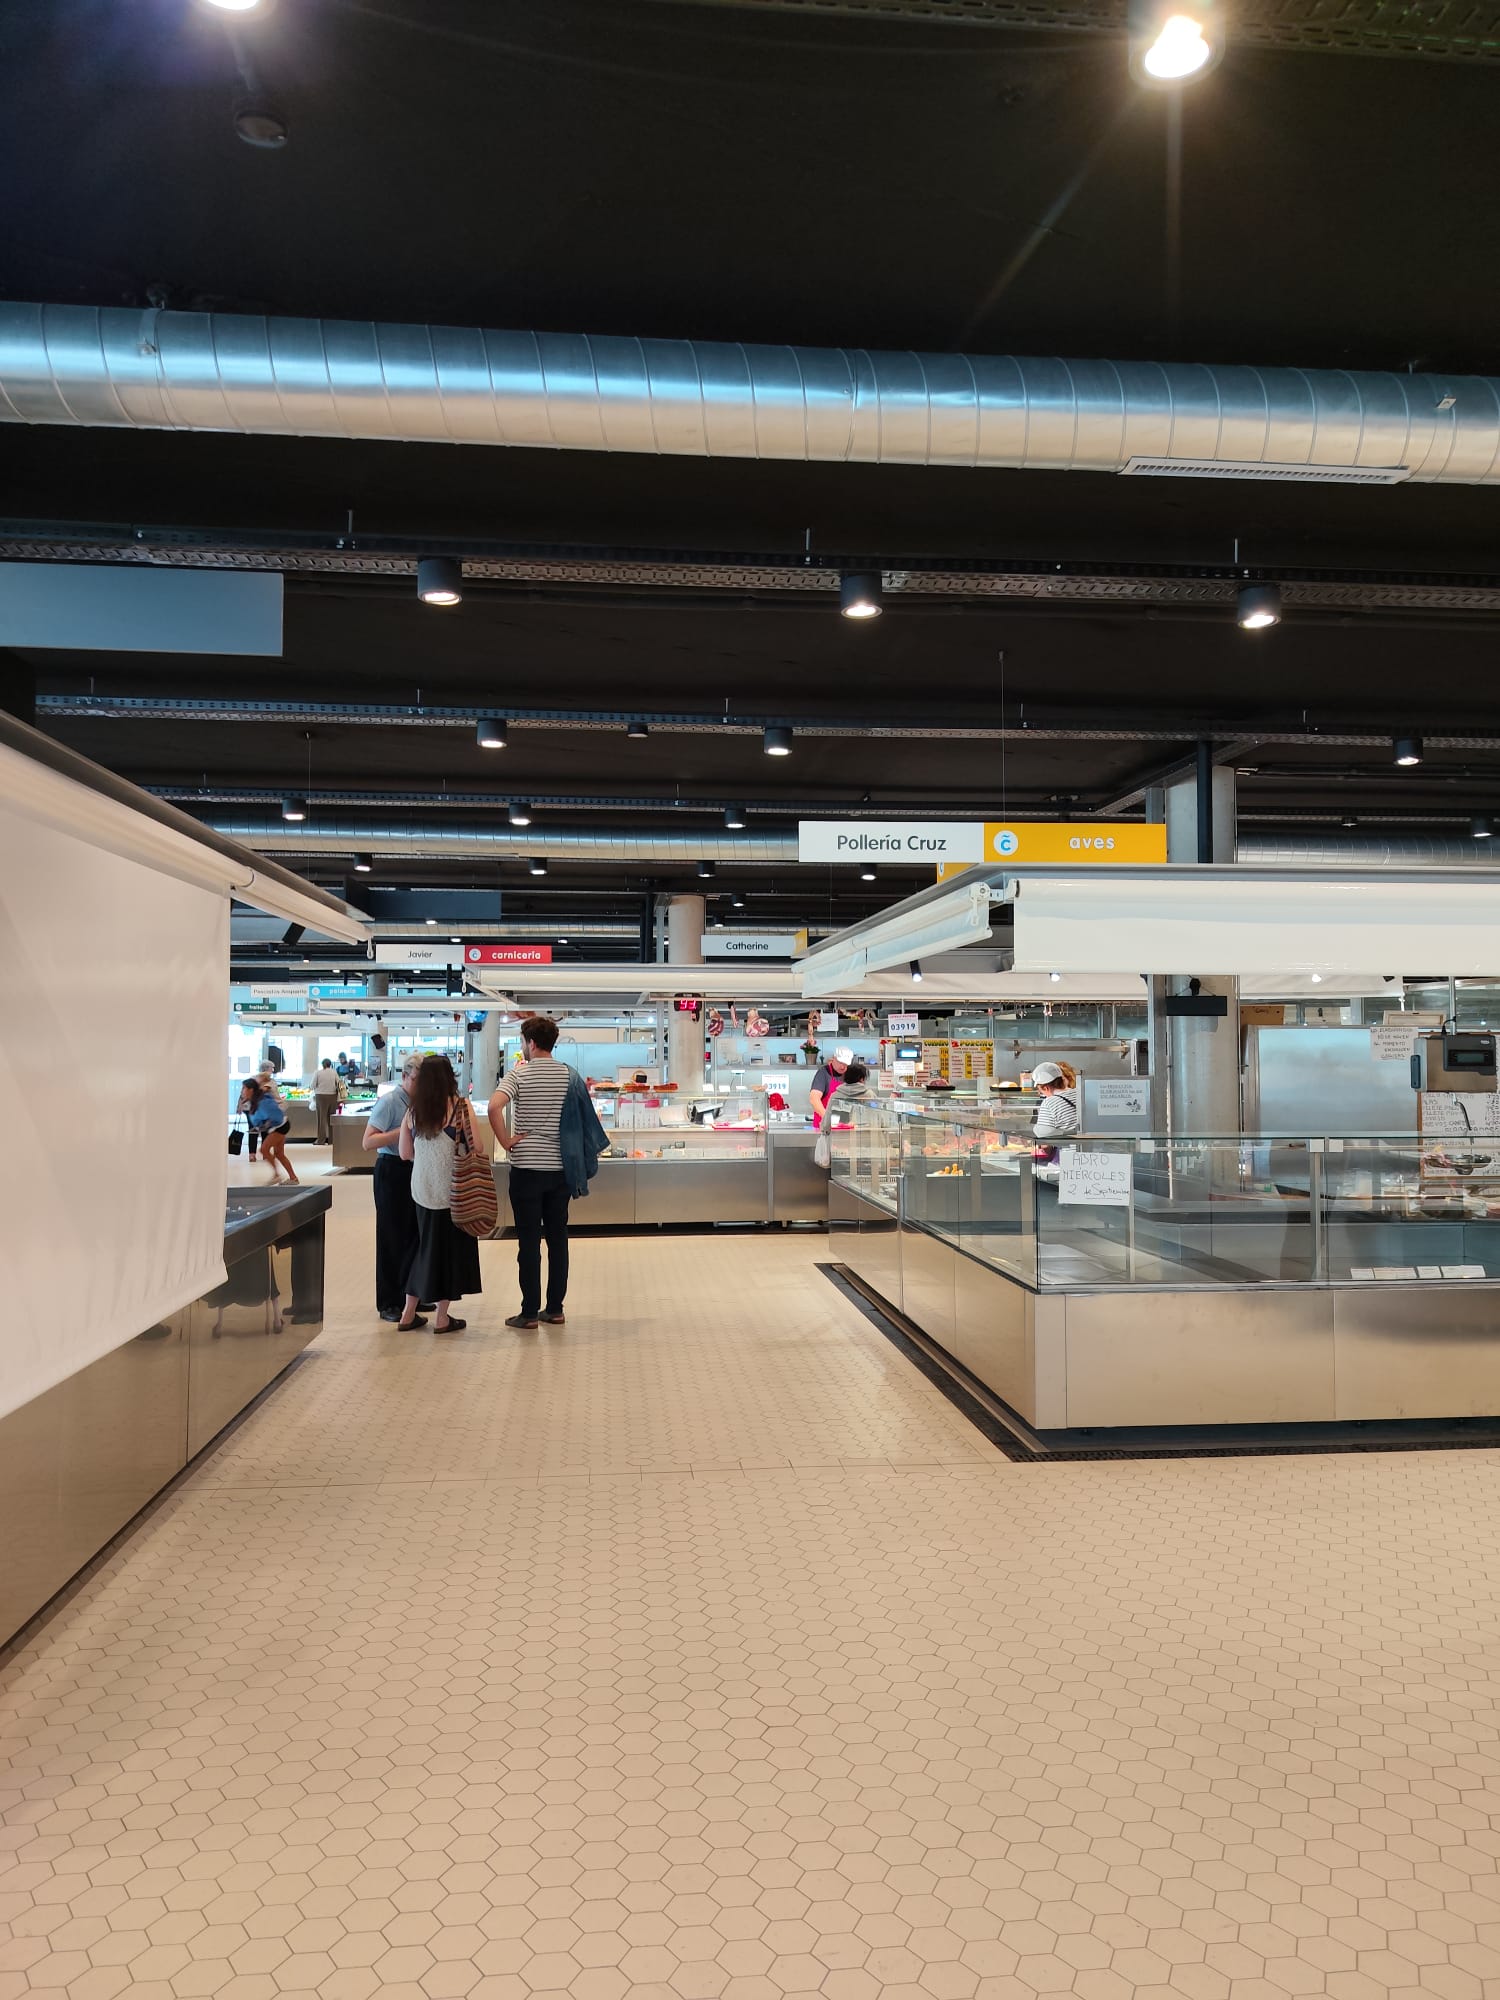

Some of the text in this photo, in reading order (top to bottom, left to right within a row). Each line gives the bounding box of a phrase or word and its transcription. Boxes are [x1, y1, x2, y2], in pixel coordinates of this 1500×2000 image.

[837, 834, 947, 851] Pollería Cruz
[1069, 836, 1115, 850] aves
[725, 942, 769, 951] Catherine
[408, 950, 433, 959] Javier
[890, 1023, 916, 1031] 03919
[1072, 1152, 1110, 1167] ABRO
[1062, 1167, 1126, 1182] MIÉRCOLES
